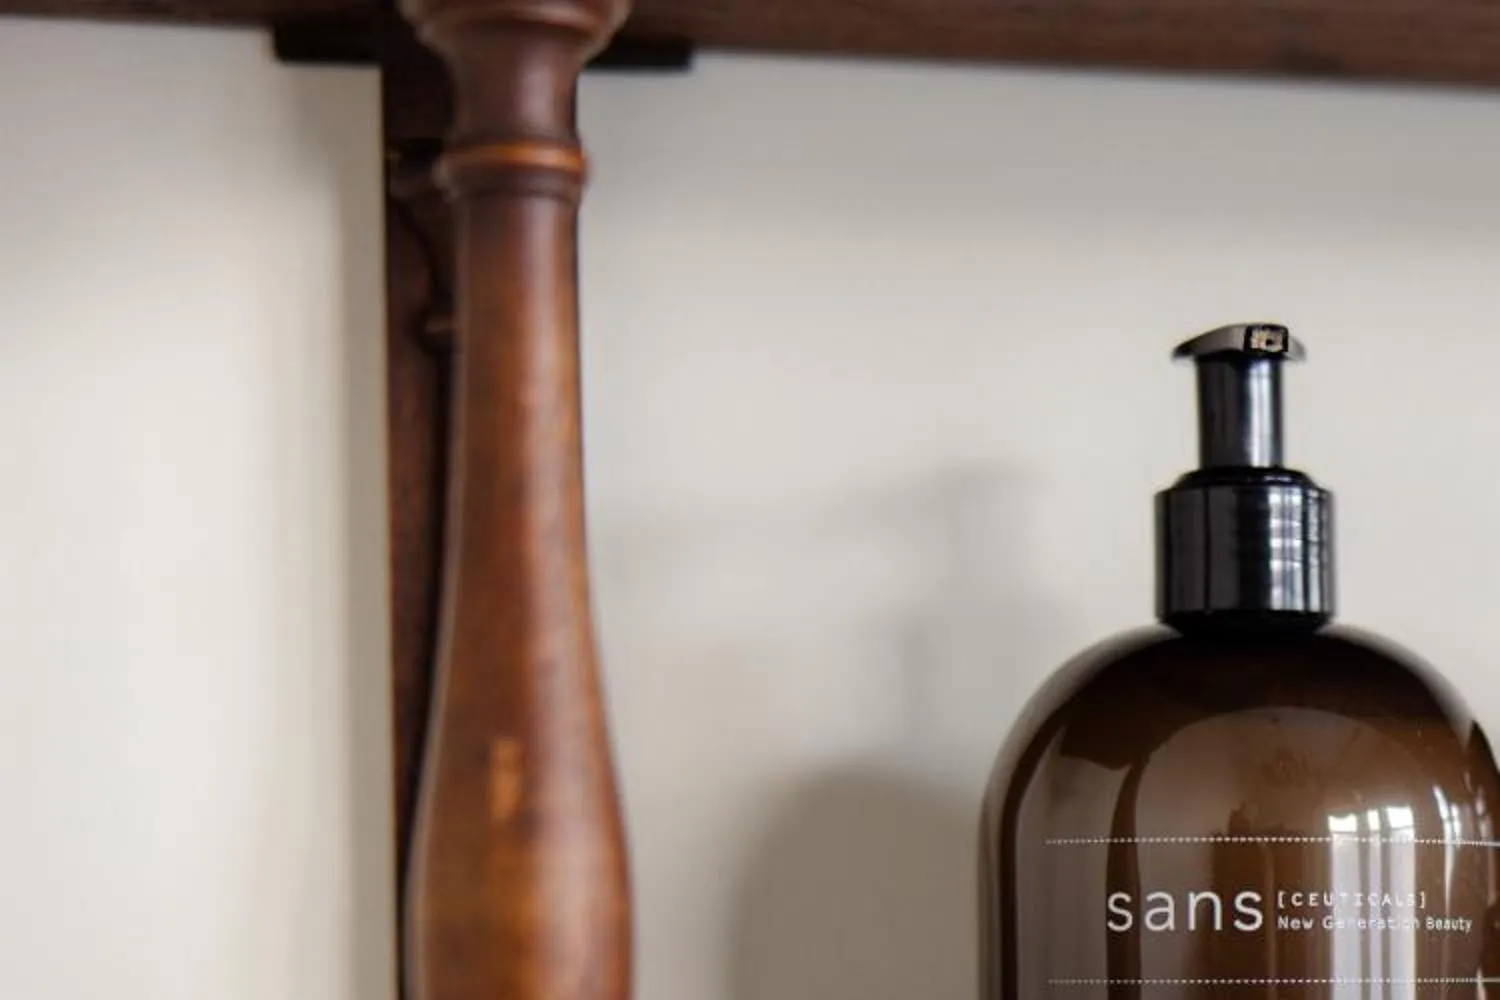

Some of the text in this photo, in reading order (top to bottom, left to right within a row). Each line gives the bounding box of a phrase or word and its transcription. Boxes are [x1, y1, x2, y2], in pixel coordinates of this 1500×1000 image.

[1278, 890, 1426, 909] [CEUTICALS]
[1106, 891, 1264, 932] sans
[1277, 916, 1314, 929] New
[1426, 916, 1473, 932] Beauty
